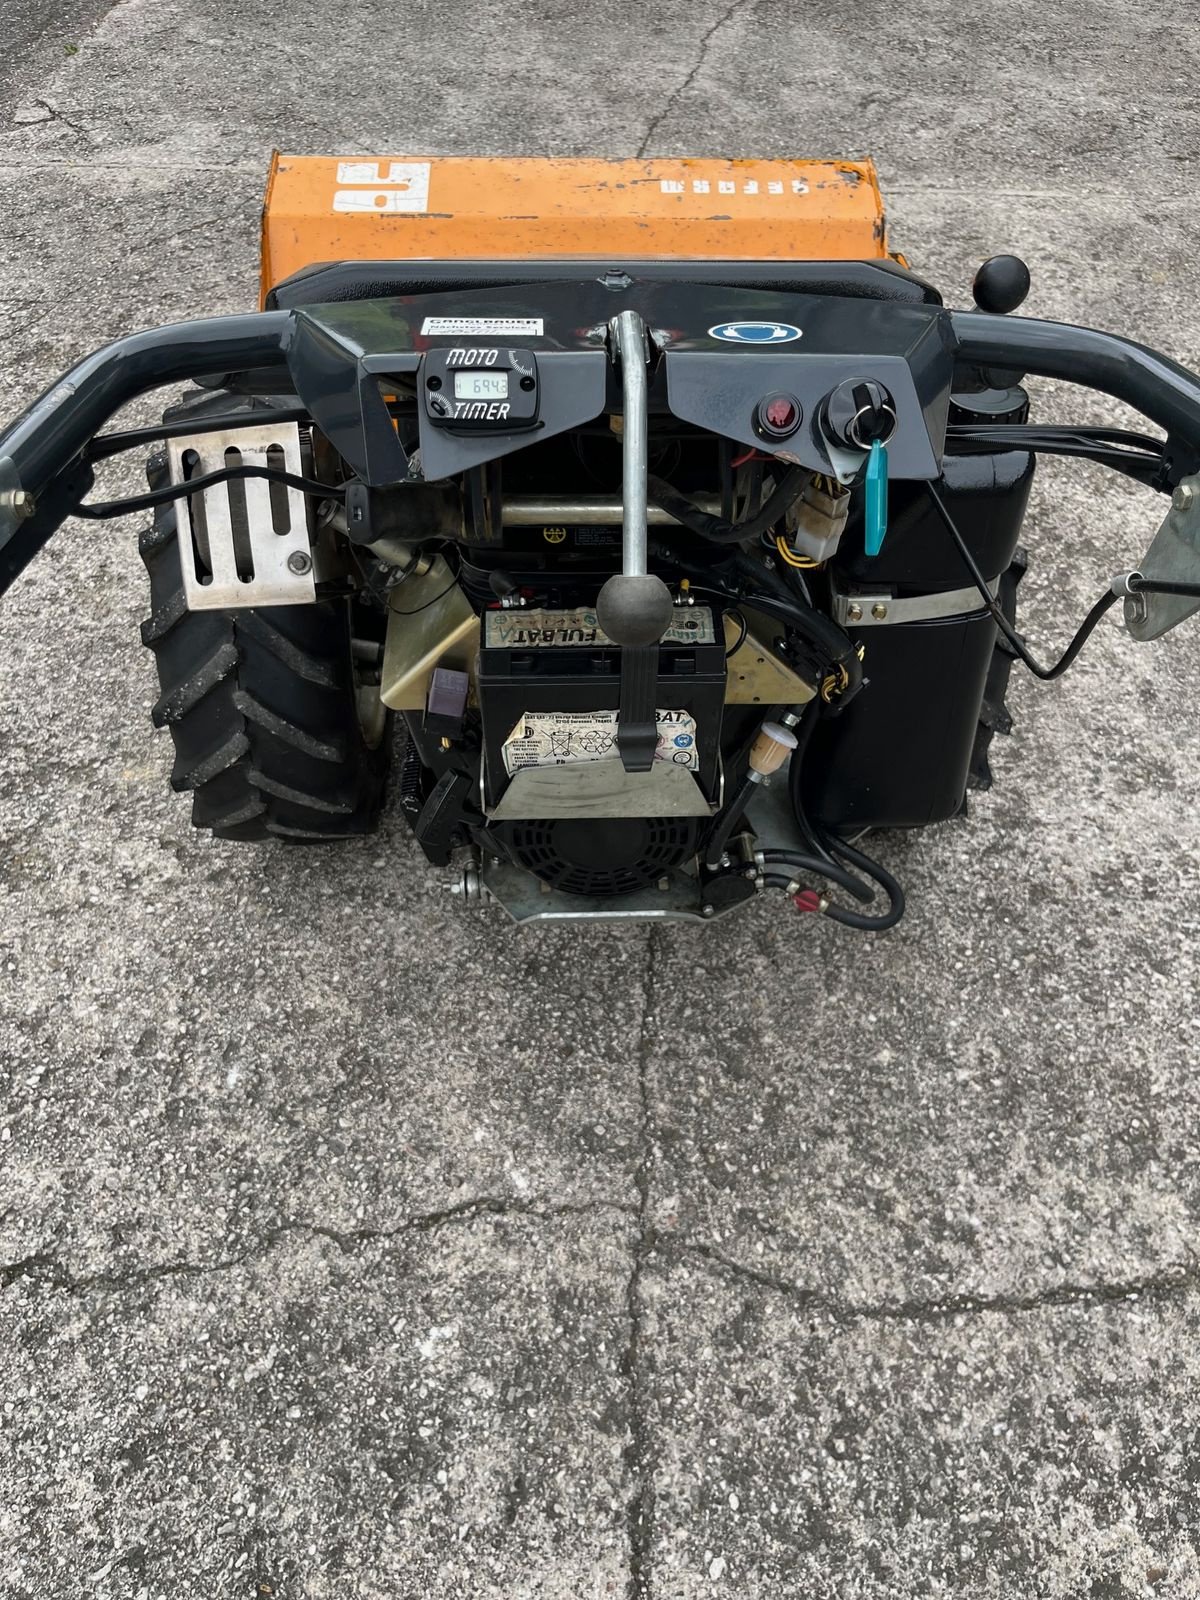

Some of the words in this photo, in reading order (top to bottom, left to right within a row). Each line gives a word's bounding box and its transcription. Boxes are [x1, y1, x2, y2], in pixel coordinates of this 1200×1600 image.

[446, 349, 498, 366] MOTO
[454, 402, 511, 420] TIMER
[513, 629, 597, 643] FULBAT
